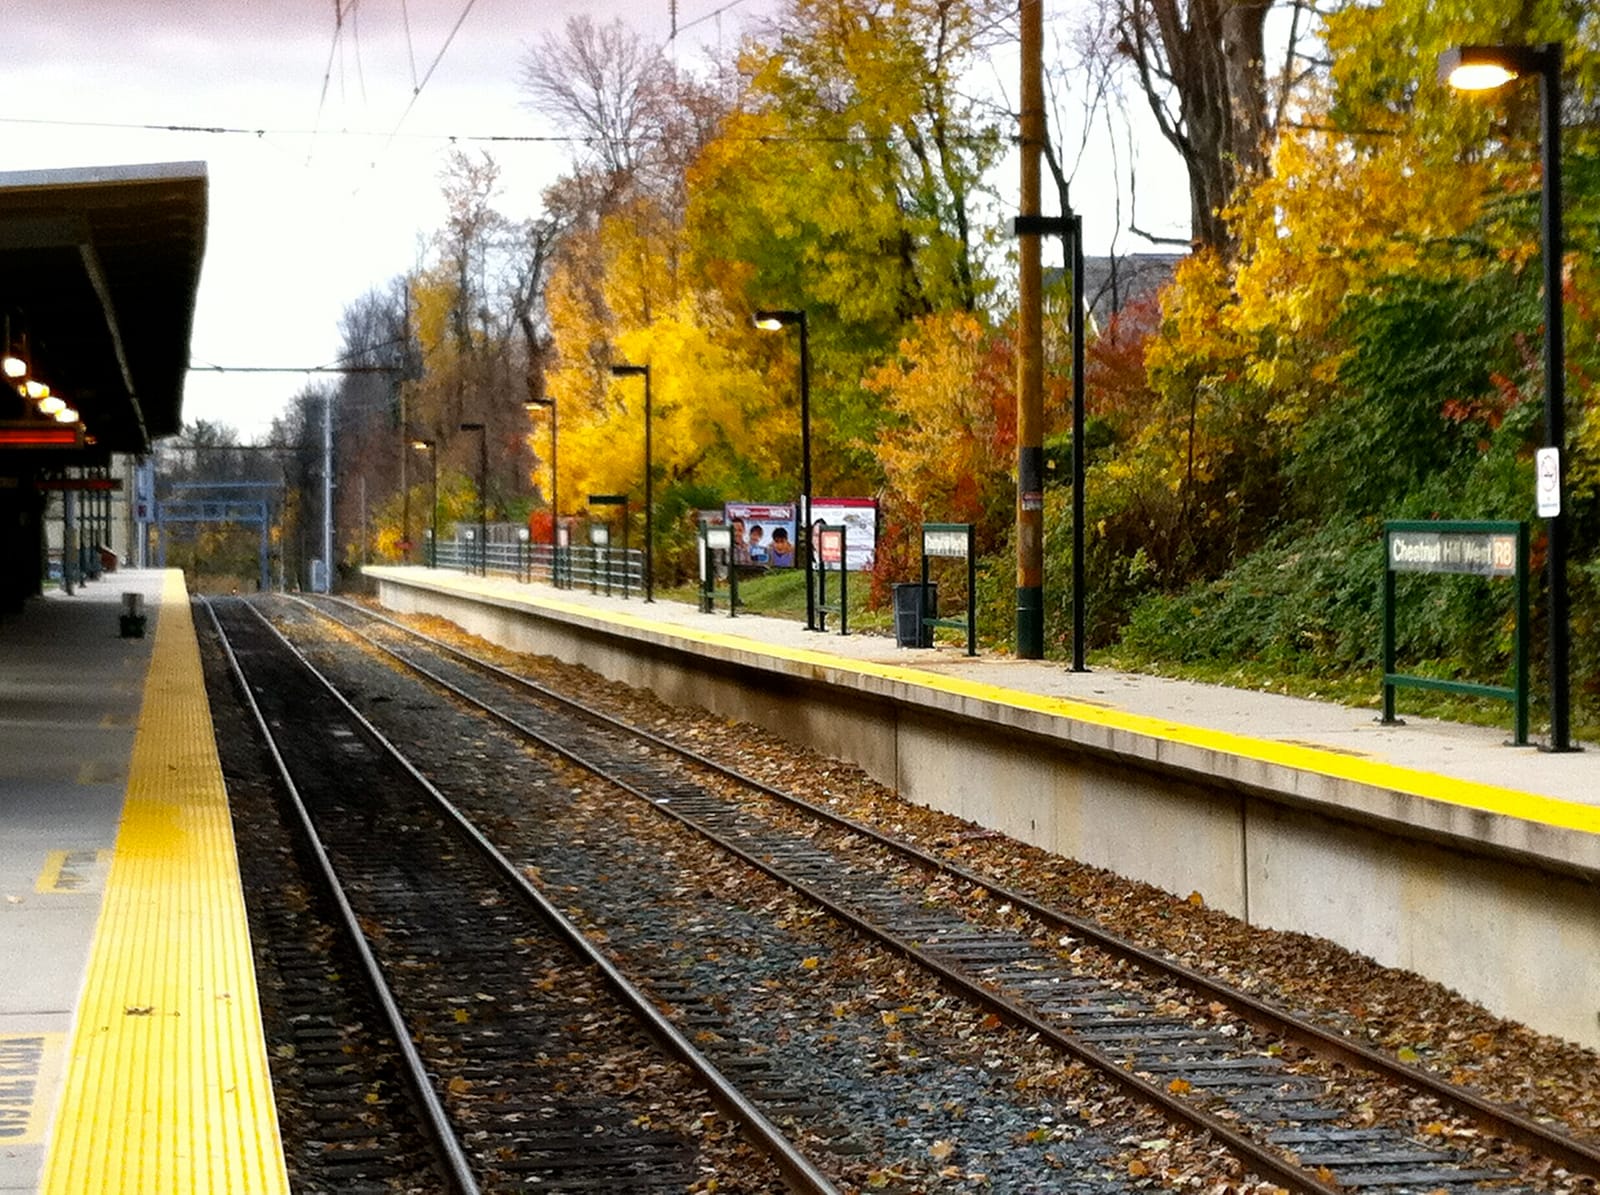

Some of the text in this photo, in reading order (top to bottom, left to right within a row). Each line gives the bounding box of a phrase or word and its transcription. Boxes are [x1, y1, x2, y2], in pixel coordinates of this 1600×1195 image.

[1392, 538, 1513, 566] Chestnut Hill West R8
